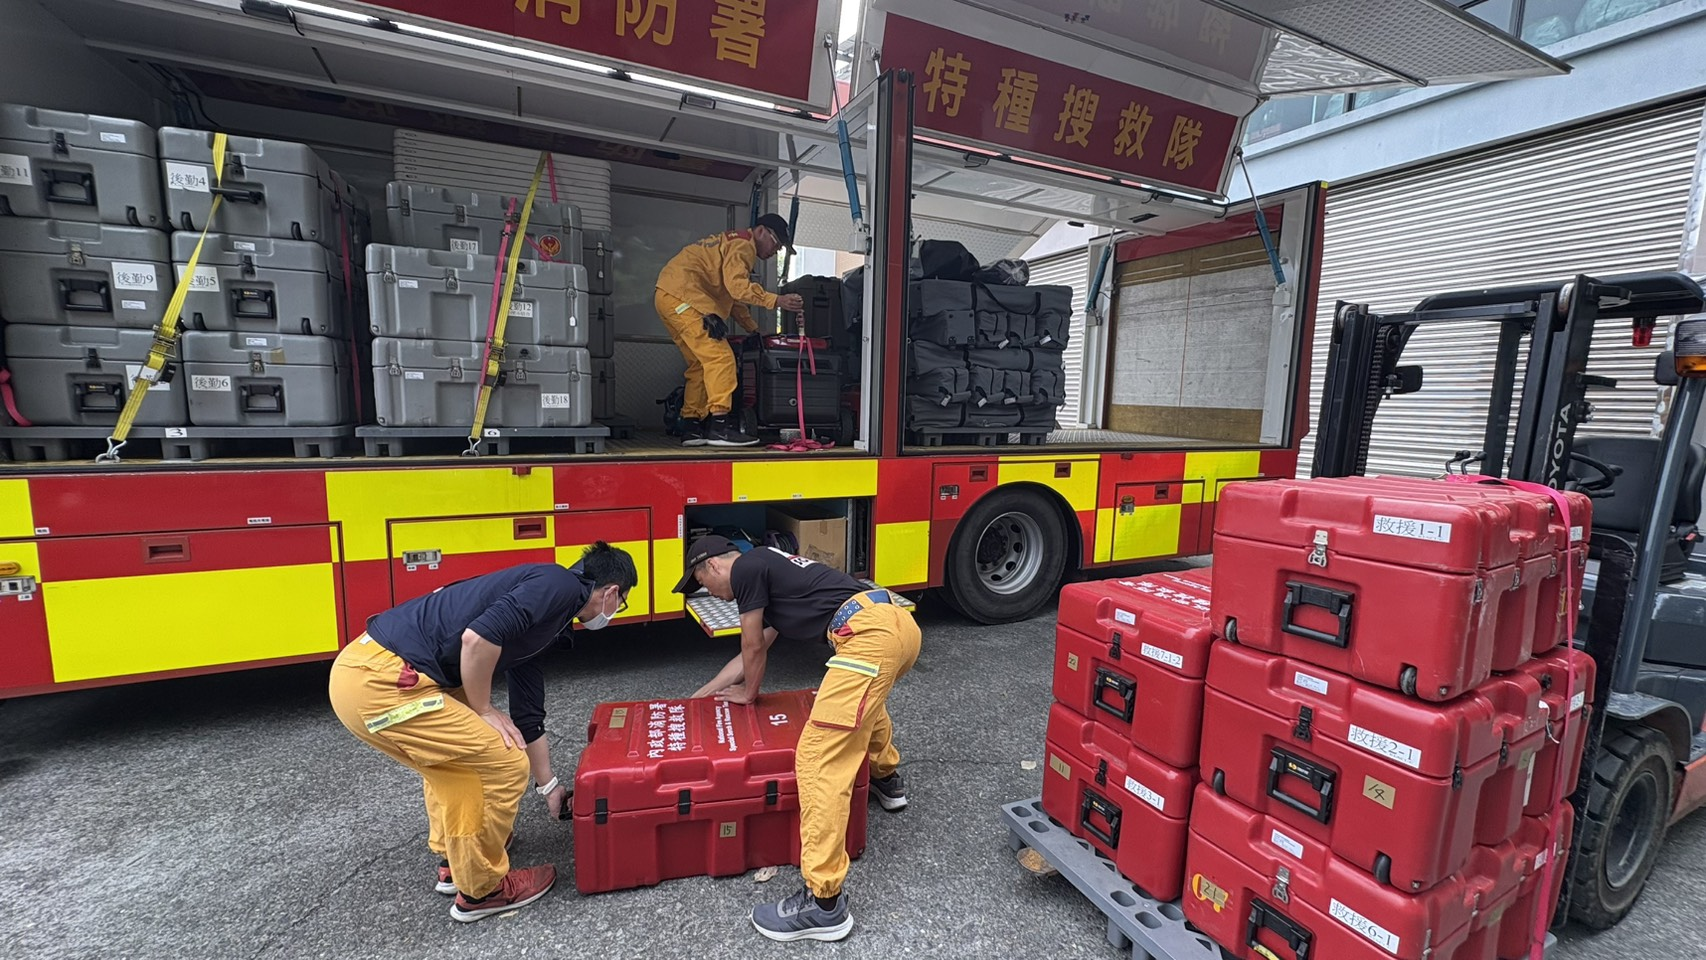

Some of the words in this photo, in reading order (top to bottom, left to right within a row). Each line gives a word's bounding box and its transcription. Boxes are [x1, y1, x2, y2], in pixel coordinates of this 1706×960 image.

[923, 48, 1202, 171] 特種搜救隊
[117, 271, 154, 285] 後勤9
[189, 275, 217, 286] 勤5
[1375, 516, 1442, 538] 救援1-1
[769, 713, 788, 726] 15
[1350, 727, 1413, 761] 救援2-1
[1127, 778, 1162, 806] 救援3-1
[723, 824, 733, 836] 15
[1204, 881, 1217, 900] 21
[1331, 901, 1391, 946] 救援6-1
